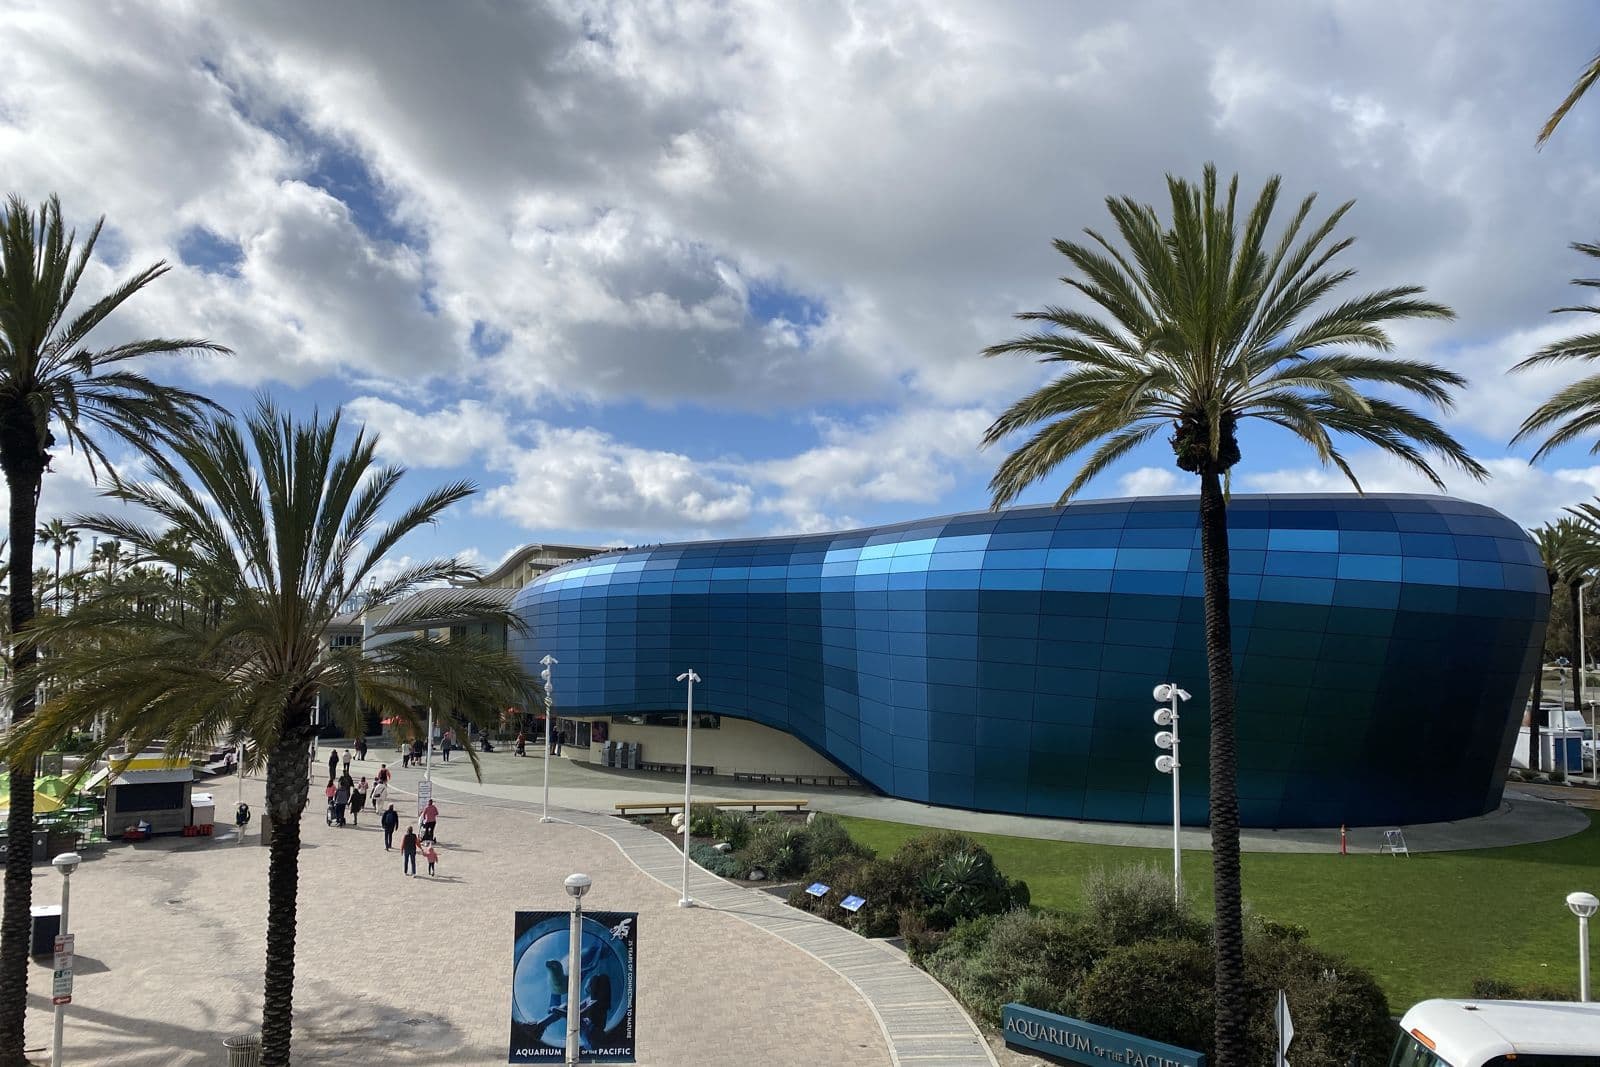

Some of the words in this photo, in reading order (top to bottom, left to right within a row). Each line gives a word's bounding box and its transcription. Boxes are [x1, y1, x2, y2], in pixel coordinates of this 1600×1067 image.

[515, 1048, 562, 1056] AQUARIUM
[598, 1048, 631, 1056] PACIFIC
[1006, 1017, 1091, 1052] AQUARIUM
[1093, 1046, 1105, 1057] OF
[1105, 1049, 1123, 1062] THE
[1126, 1048, 1192, 1067] PACIF
